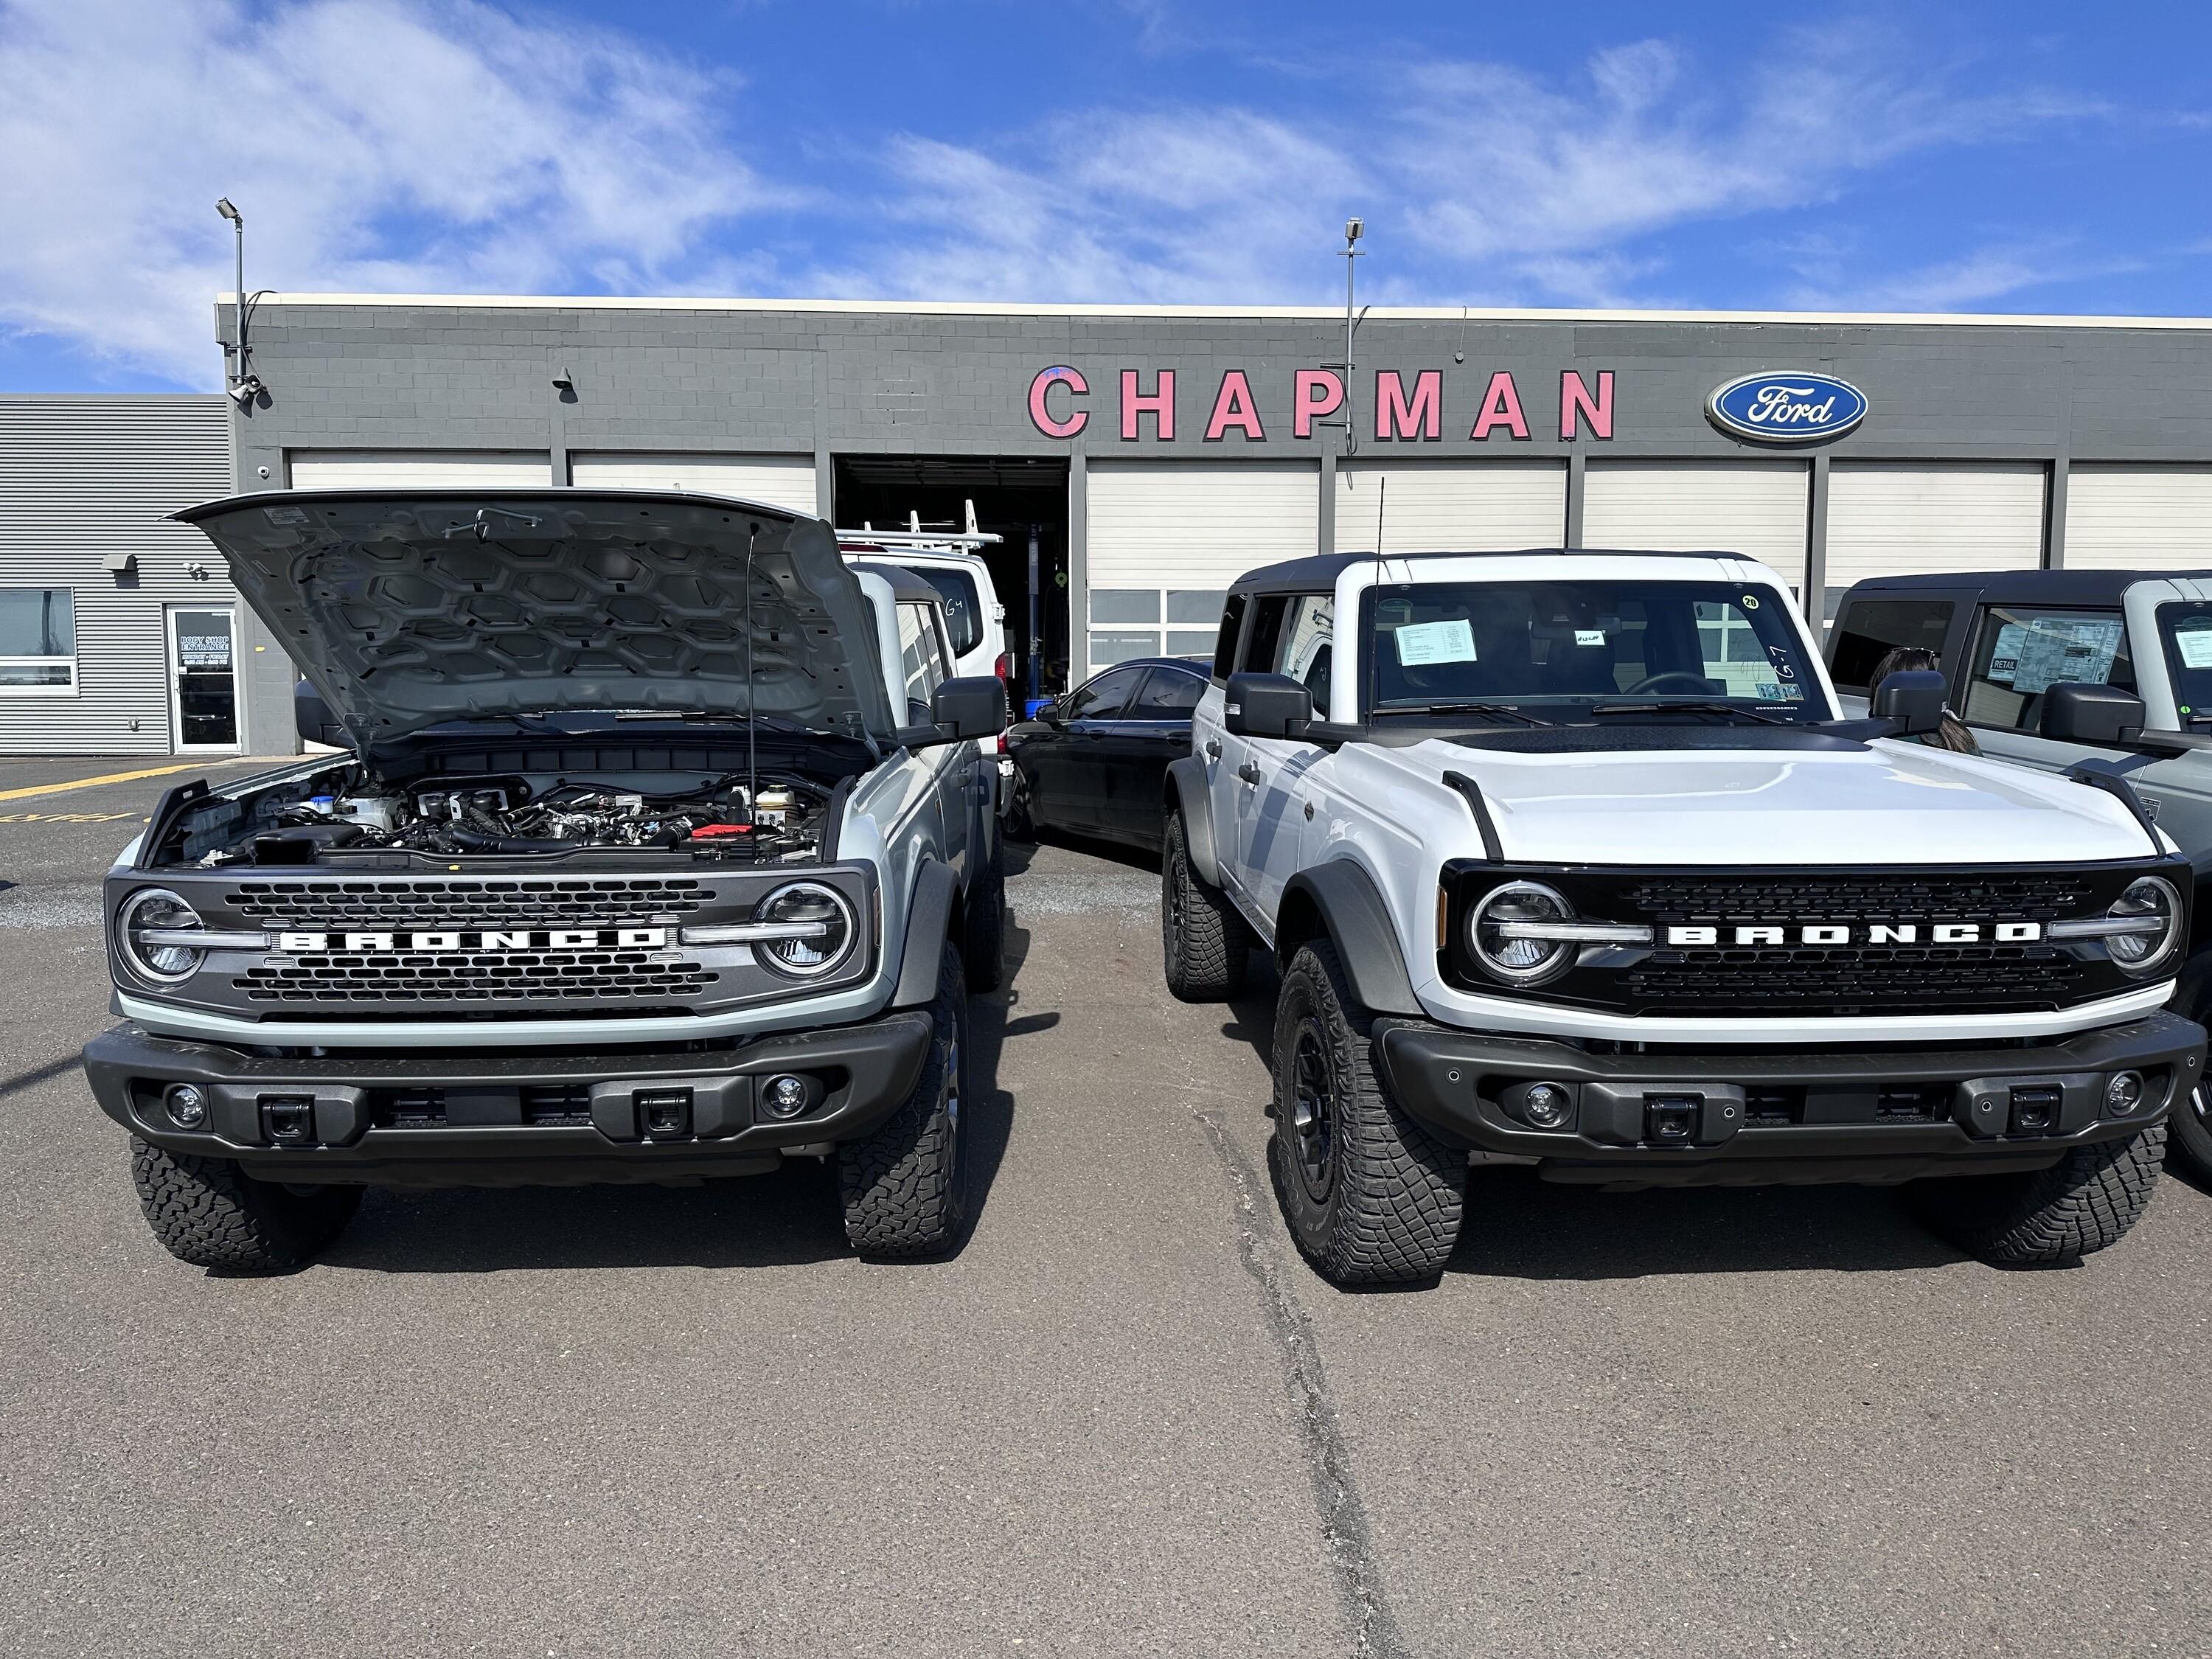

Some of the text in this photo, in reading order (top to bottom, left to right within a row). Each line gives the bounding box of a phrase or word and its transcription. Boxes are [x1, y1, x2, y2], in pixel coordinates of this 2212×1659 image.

[1028, 365, 1615, 442] CHAPMAN
[1747, 386, 1836, 423] Ford
[1745, 597, 1756, 607] 20
[1994, 660, 2015, 669] RETAIL
[279, 931, 666, 951] BRONCO
[1668, 923, 2041, 945] BRONCO
